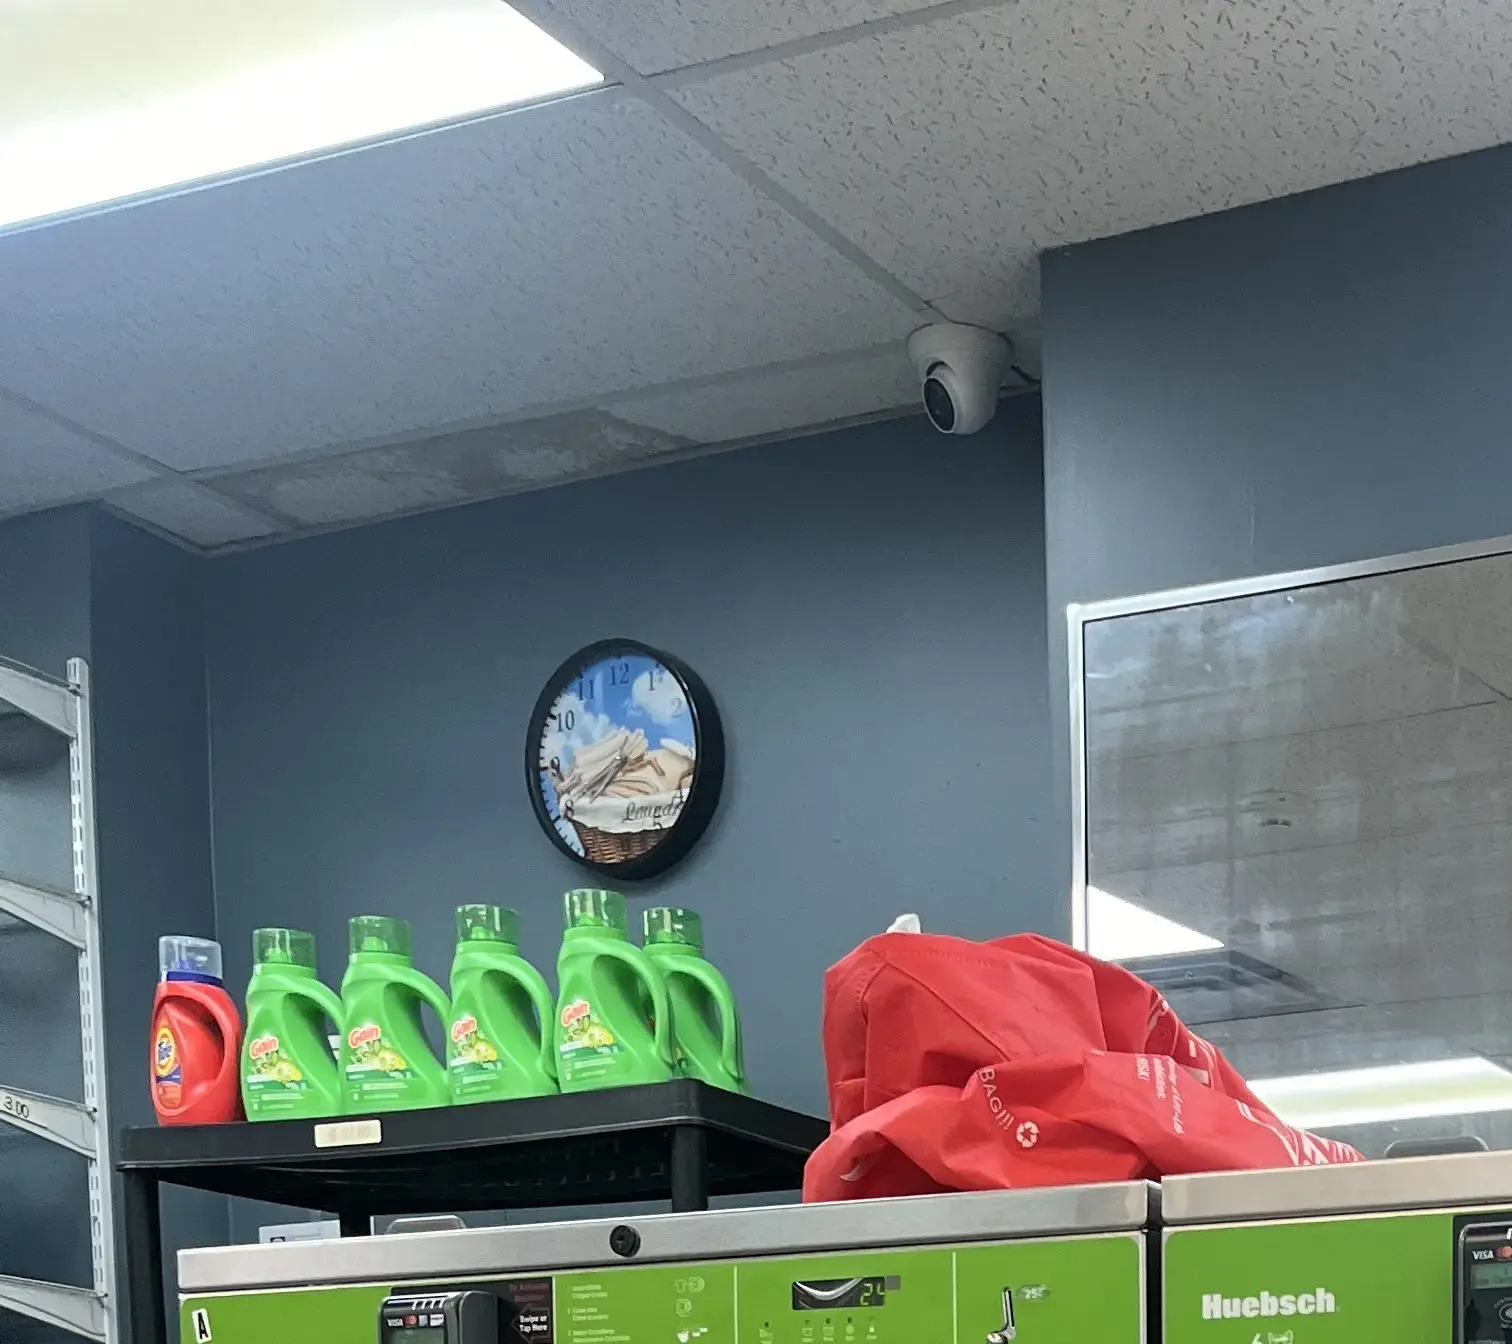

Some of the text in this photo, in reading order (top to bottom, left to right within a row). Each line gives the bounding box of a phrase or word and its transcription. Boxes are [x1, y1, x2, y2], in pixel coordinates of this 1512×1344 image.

[610, 663, 629, 685] 12
[671, 698, 682, 718] 2
[557, 710, 575, 732] 10
[350, 1026, 380, 1047] Gain
[250, 1038, 278, 1058] Gain
[1472, 1250, 1494, 1260] VISA
[1202, 1287, 1336, 1320] Huebsch
[197, 1311, 209, 1340] A
